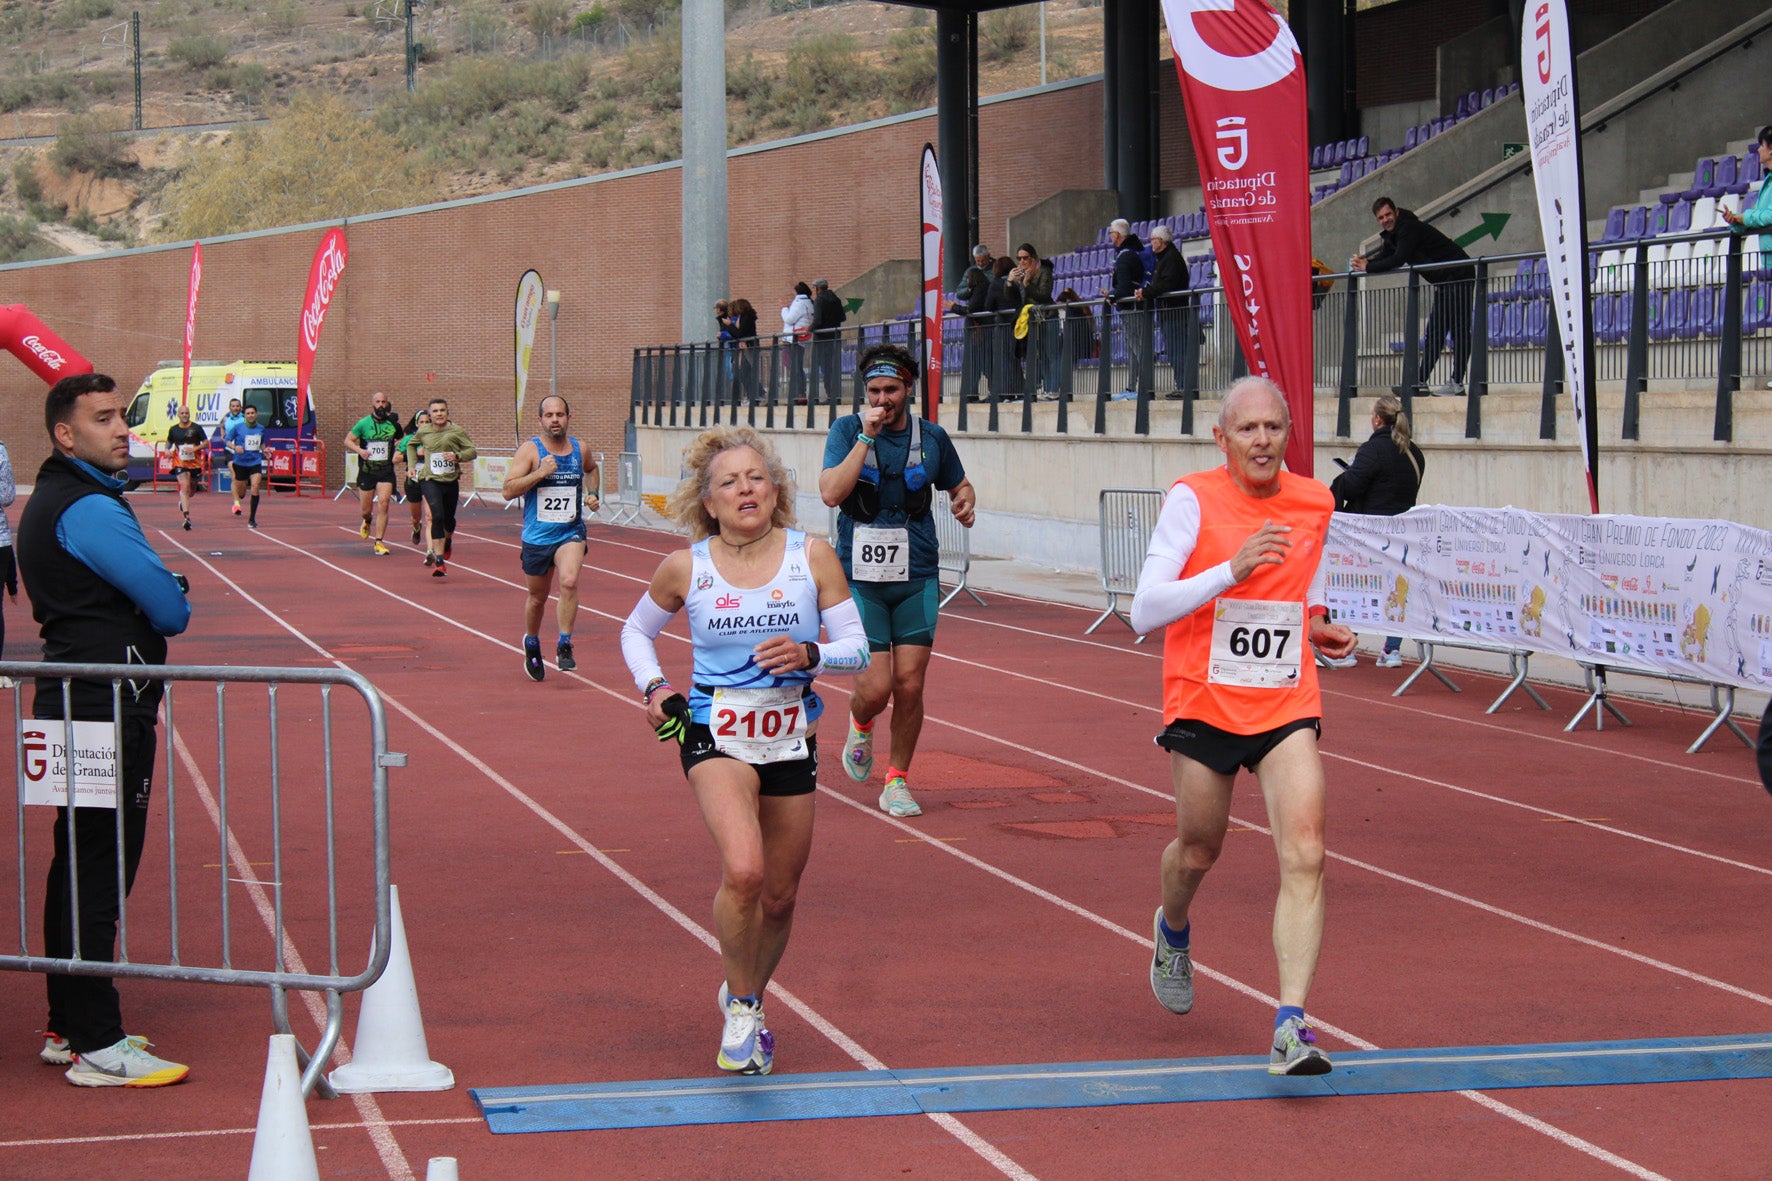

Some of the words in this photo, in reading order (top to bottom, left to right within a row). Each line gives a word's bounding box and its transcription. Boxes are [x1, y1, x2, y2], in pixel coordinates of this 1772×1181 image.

[250, 377, 298, 386] AMBULANCI
[196, 393, 221, 411] UVI
[372, 447, 386, 455] 705
[544, 497, 570, 511] 227
[1439, 510, 1458, 533] GRAN
[1581, 518, 1603, 544] GRAN
[1606, 519, 1642, 546] PREMIO
[1644, 526, 1660, 548] DE
[1661, 522, 1697, 550] FONDO
[1697, 524, 1729, 552] 2023
[861, 544, 900, 564] 897
[1599, 549, 1637, 568] UNIVERSO
[1640, 551, 1666, 568] LORCA
[708, 612, 800, 631] MARACENA
[1229, 626, 1291, 659] 607
[717, 705, 800, 739] 2107
[52, 762, 67, 776] de
[73, 763, 117, 778] Granad
